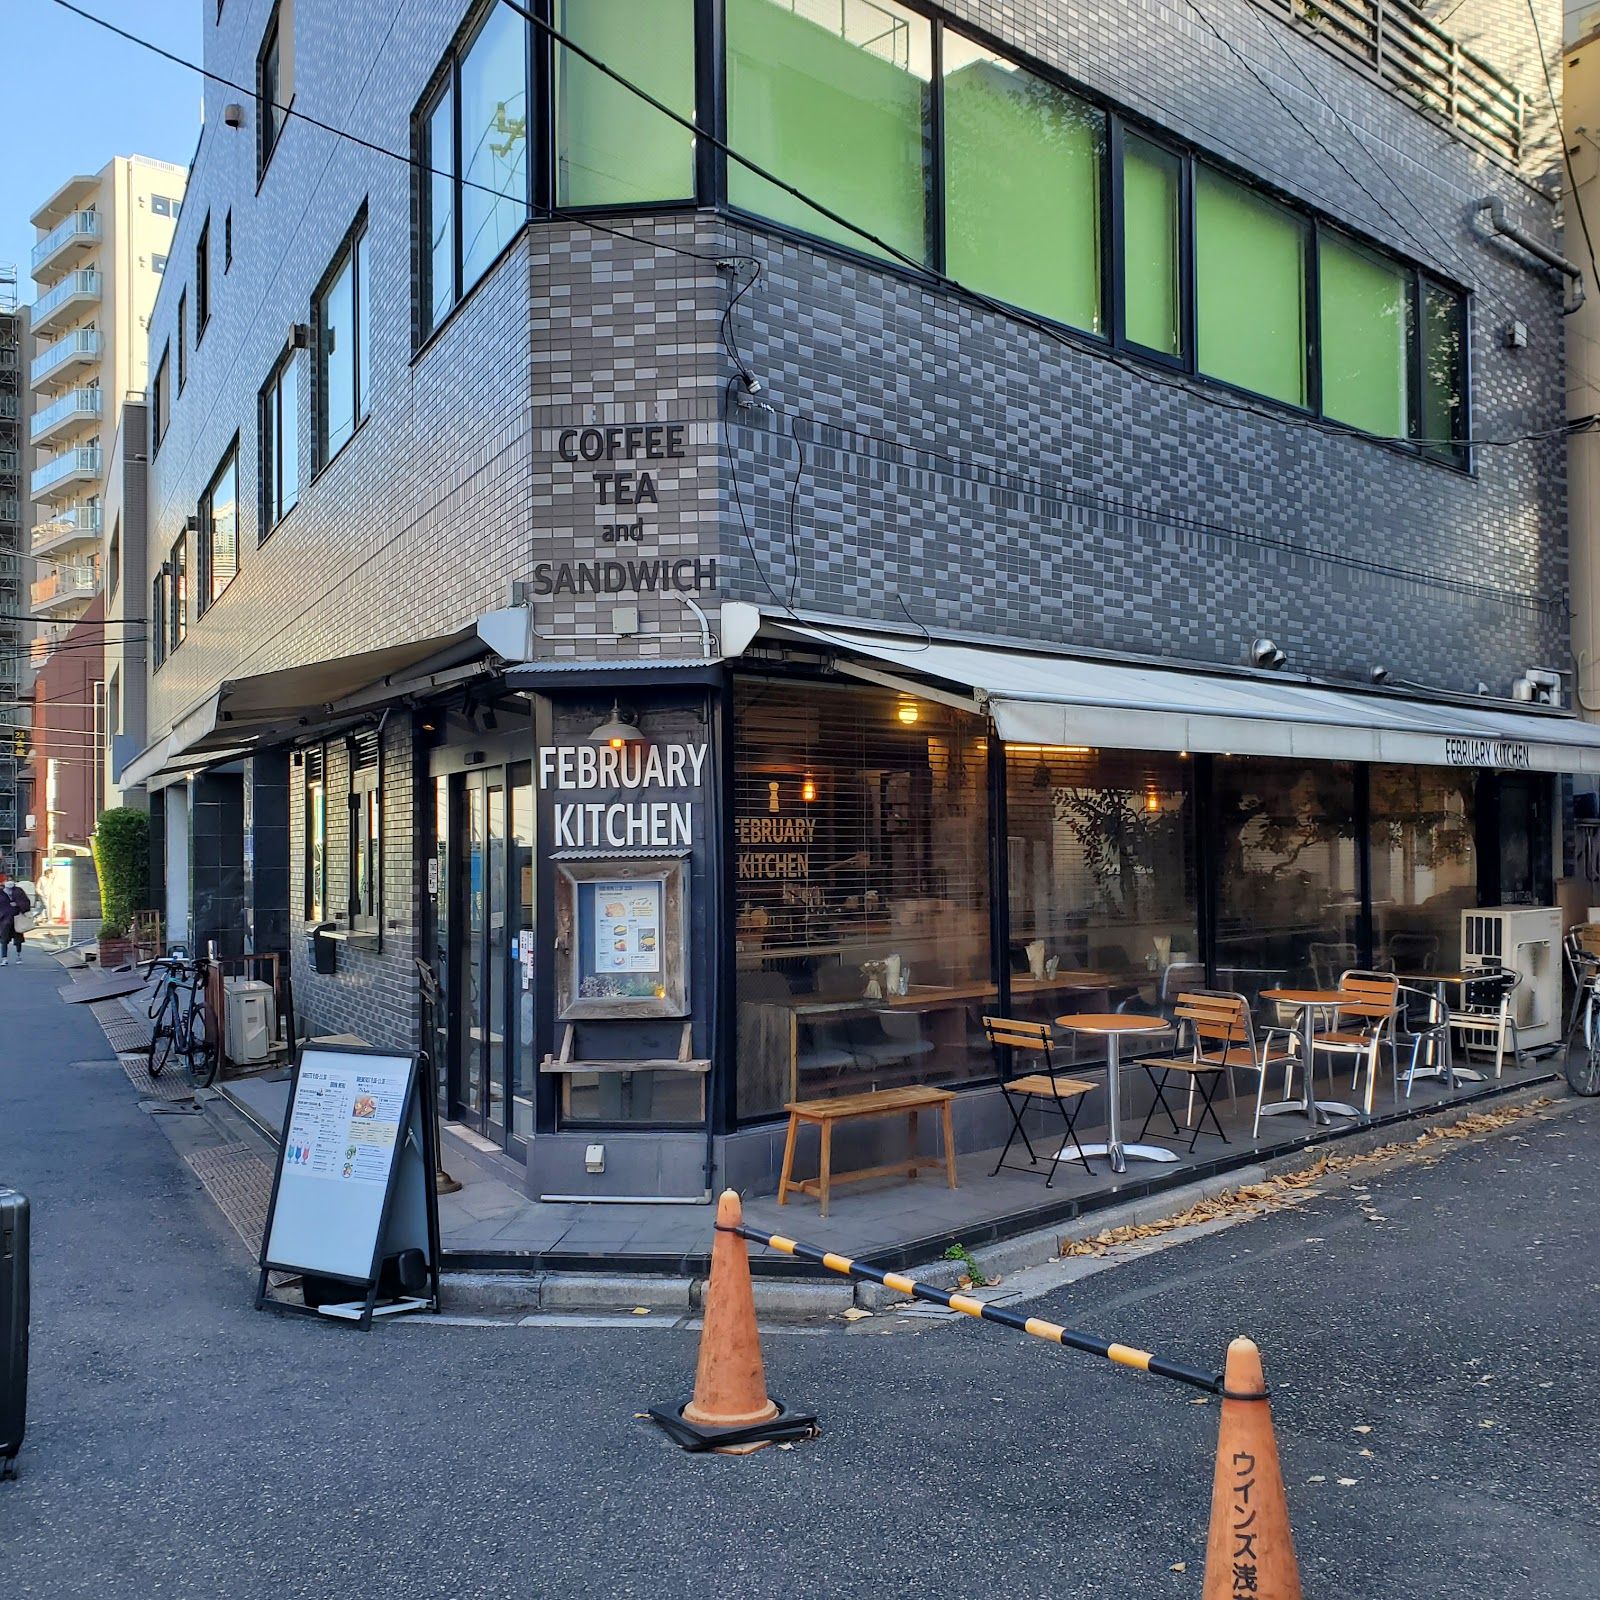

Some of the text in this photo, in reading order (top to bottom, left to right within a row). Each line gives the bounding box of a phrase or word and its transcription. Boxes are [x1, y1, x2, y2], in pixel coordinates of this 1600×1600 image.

[558, 425, 685, 462] COFFEE
[593, 472, 658, 505] TEA
[602, 517, 643, 542] and
[534, 558, 716, 595] SANDWICH
[539, 743, 708, 790] FEBRUARY
[1445, 738, 1529, 768] FEBRUARY KITCHEN
[554, 802, 693, 847] KITCHEN
[739, 854, 808, 879] KITCHEN
[1232, 1450, 1257, 1600] ウインズ浅
